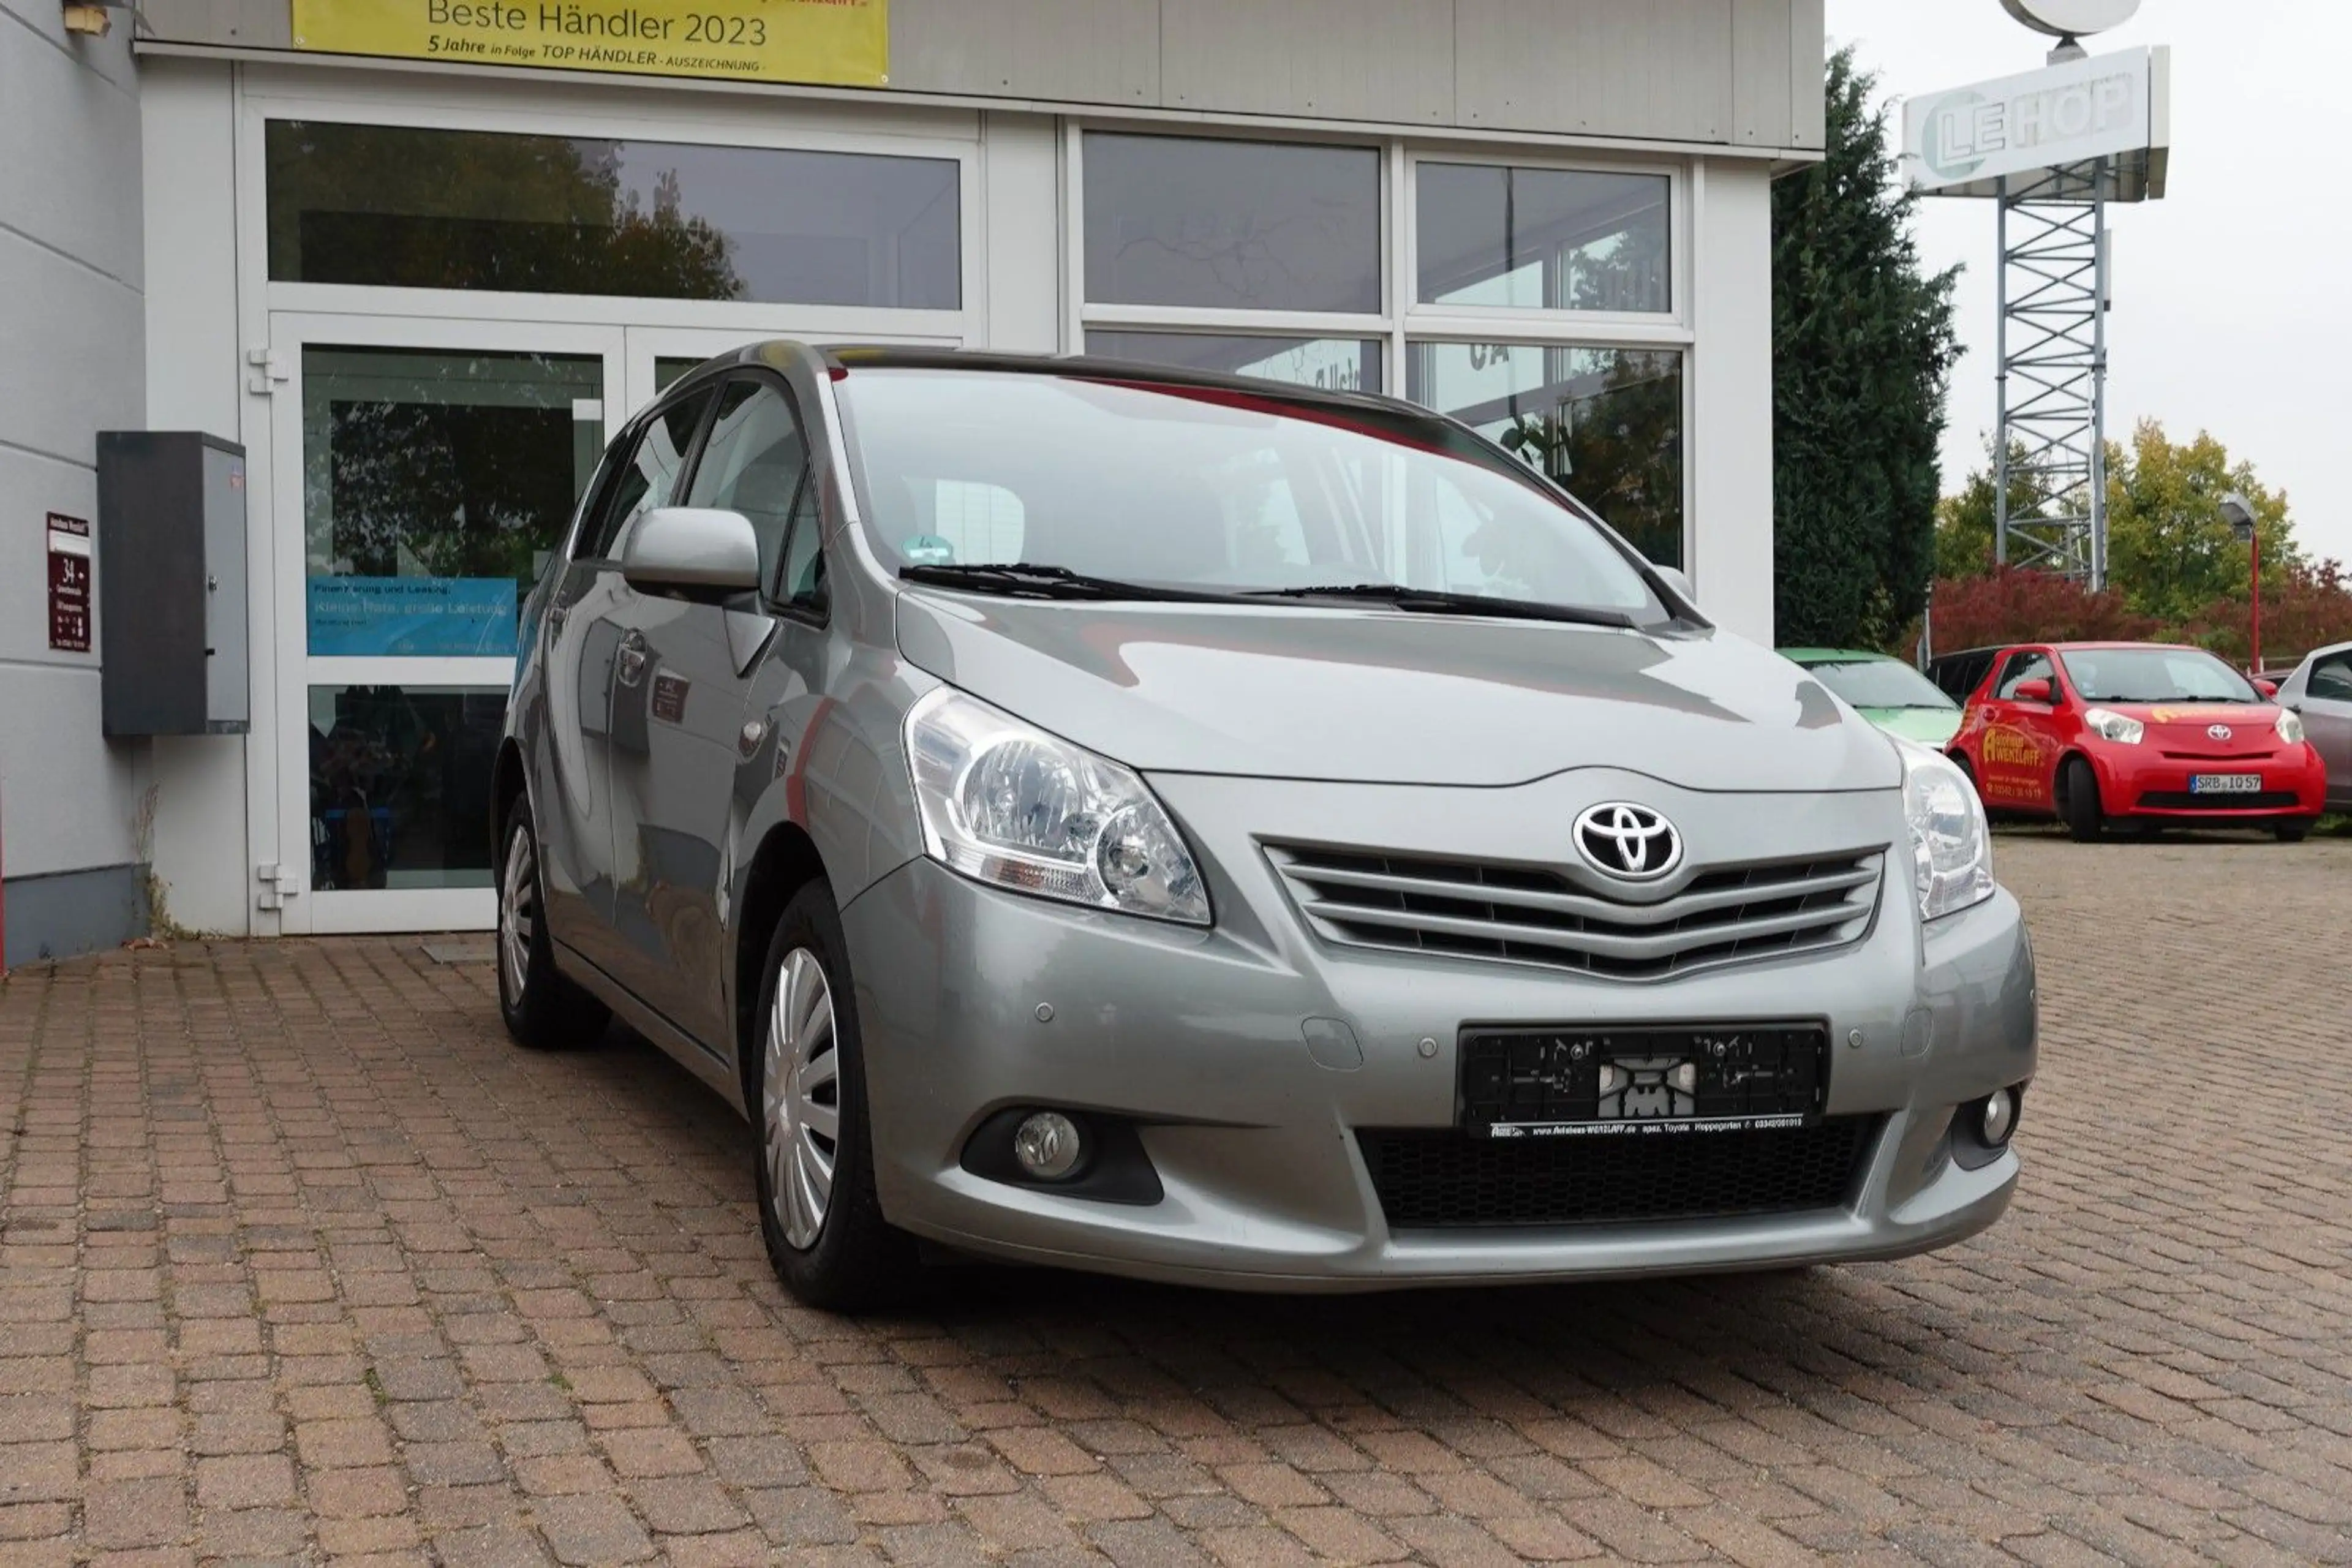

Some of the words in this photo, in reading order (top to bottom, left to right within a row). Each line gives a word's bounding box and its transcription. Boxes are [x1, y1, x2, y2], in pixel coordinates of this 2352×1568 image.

[429, 0, 526, 30] Beste
[540, 4, 675, 39] Händler
[685, 13, 766, 46] 2023
[428, 35, 440, 52] 5
[442, 37, 485, 53] Jahre
[490, 44, 502, 56] in
[504, 45, 536, 59] Folge
[543, 45, 575, 59] TOP
[578, 45, 657, 64] HÄNDLER
[666, 56, 760, 72] AUSZEICHNUNG
[385, 584, 404, 594] und
[2198, 776, 2220, 789] SRB
[2245, 776, 2260, 789] 57
[1664, 1123, 1690, 1133] Toyota
